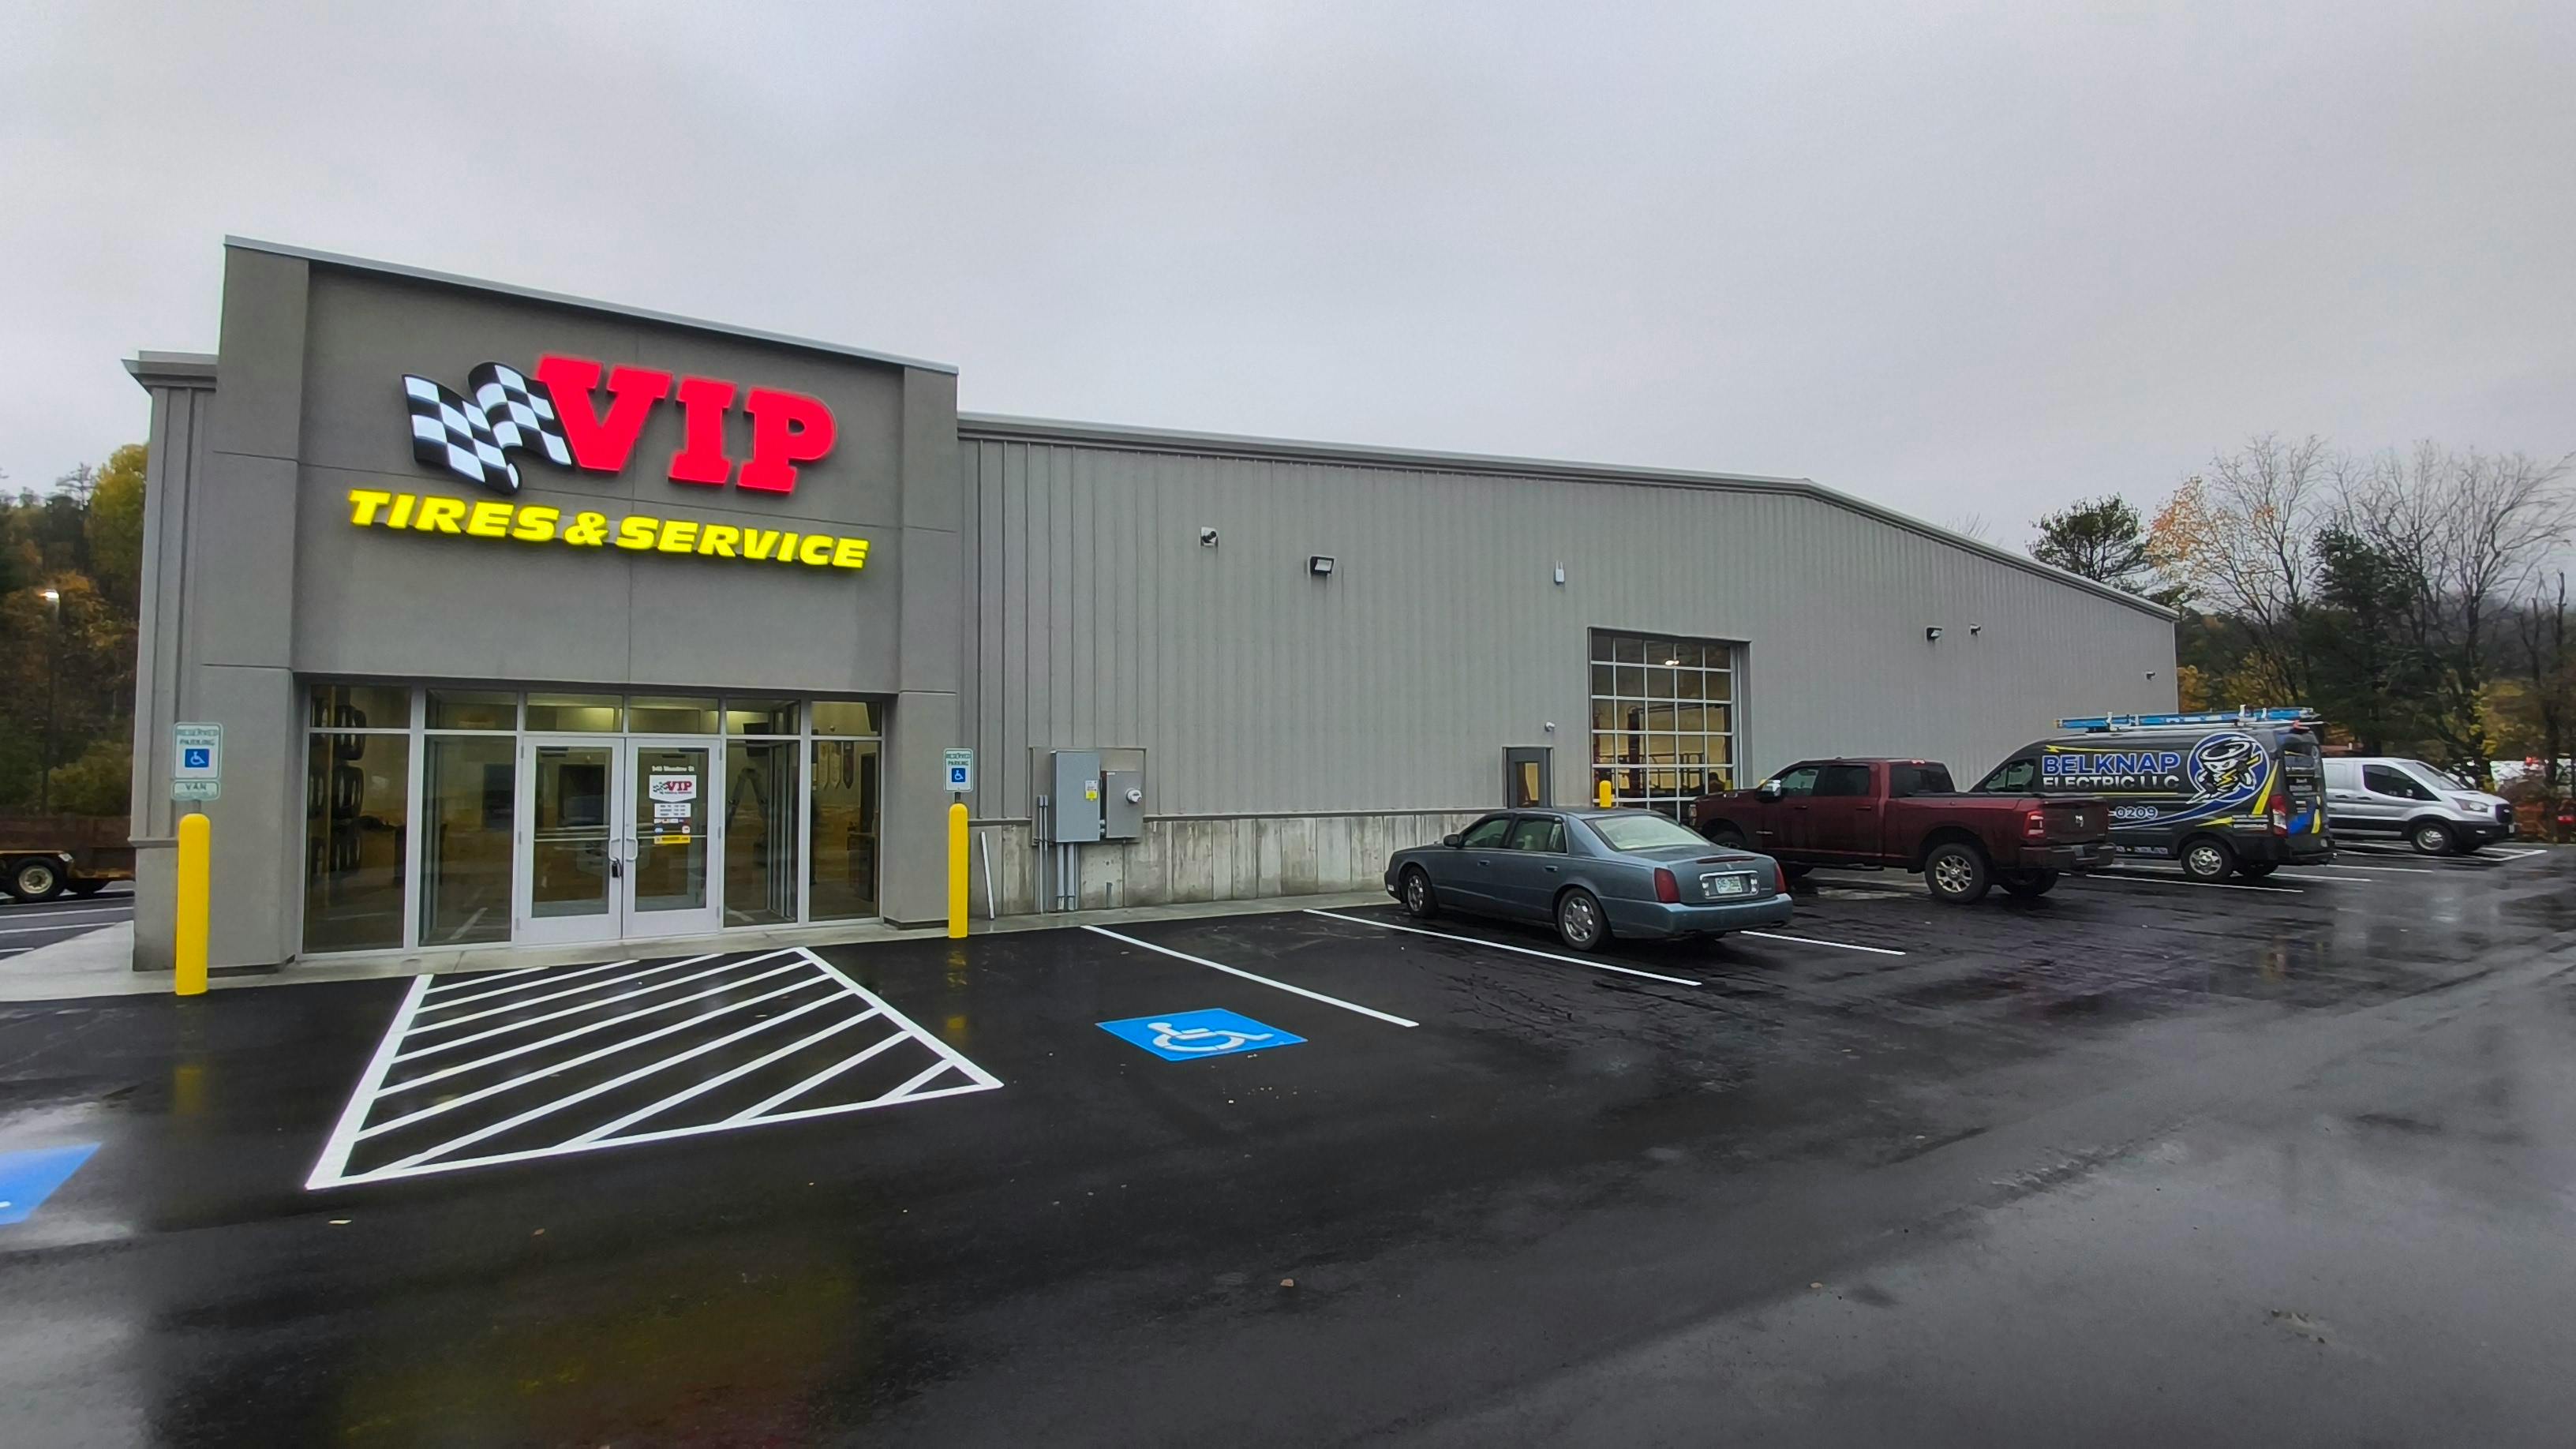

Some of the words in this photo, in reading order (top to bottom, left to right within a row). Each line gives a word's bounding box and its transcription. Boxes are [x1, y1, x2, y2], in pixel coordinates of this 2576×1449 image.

[535, 354, 837, 494] VIP
[347, 489, 560, 543] TIRES
[563, 511, 608, 547] &
[616, 515, 870, 570] SERVICE
[665, 781, 692, 792] VIP
[2042, 751, 2181, 776] BELKNAP
